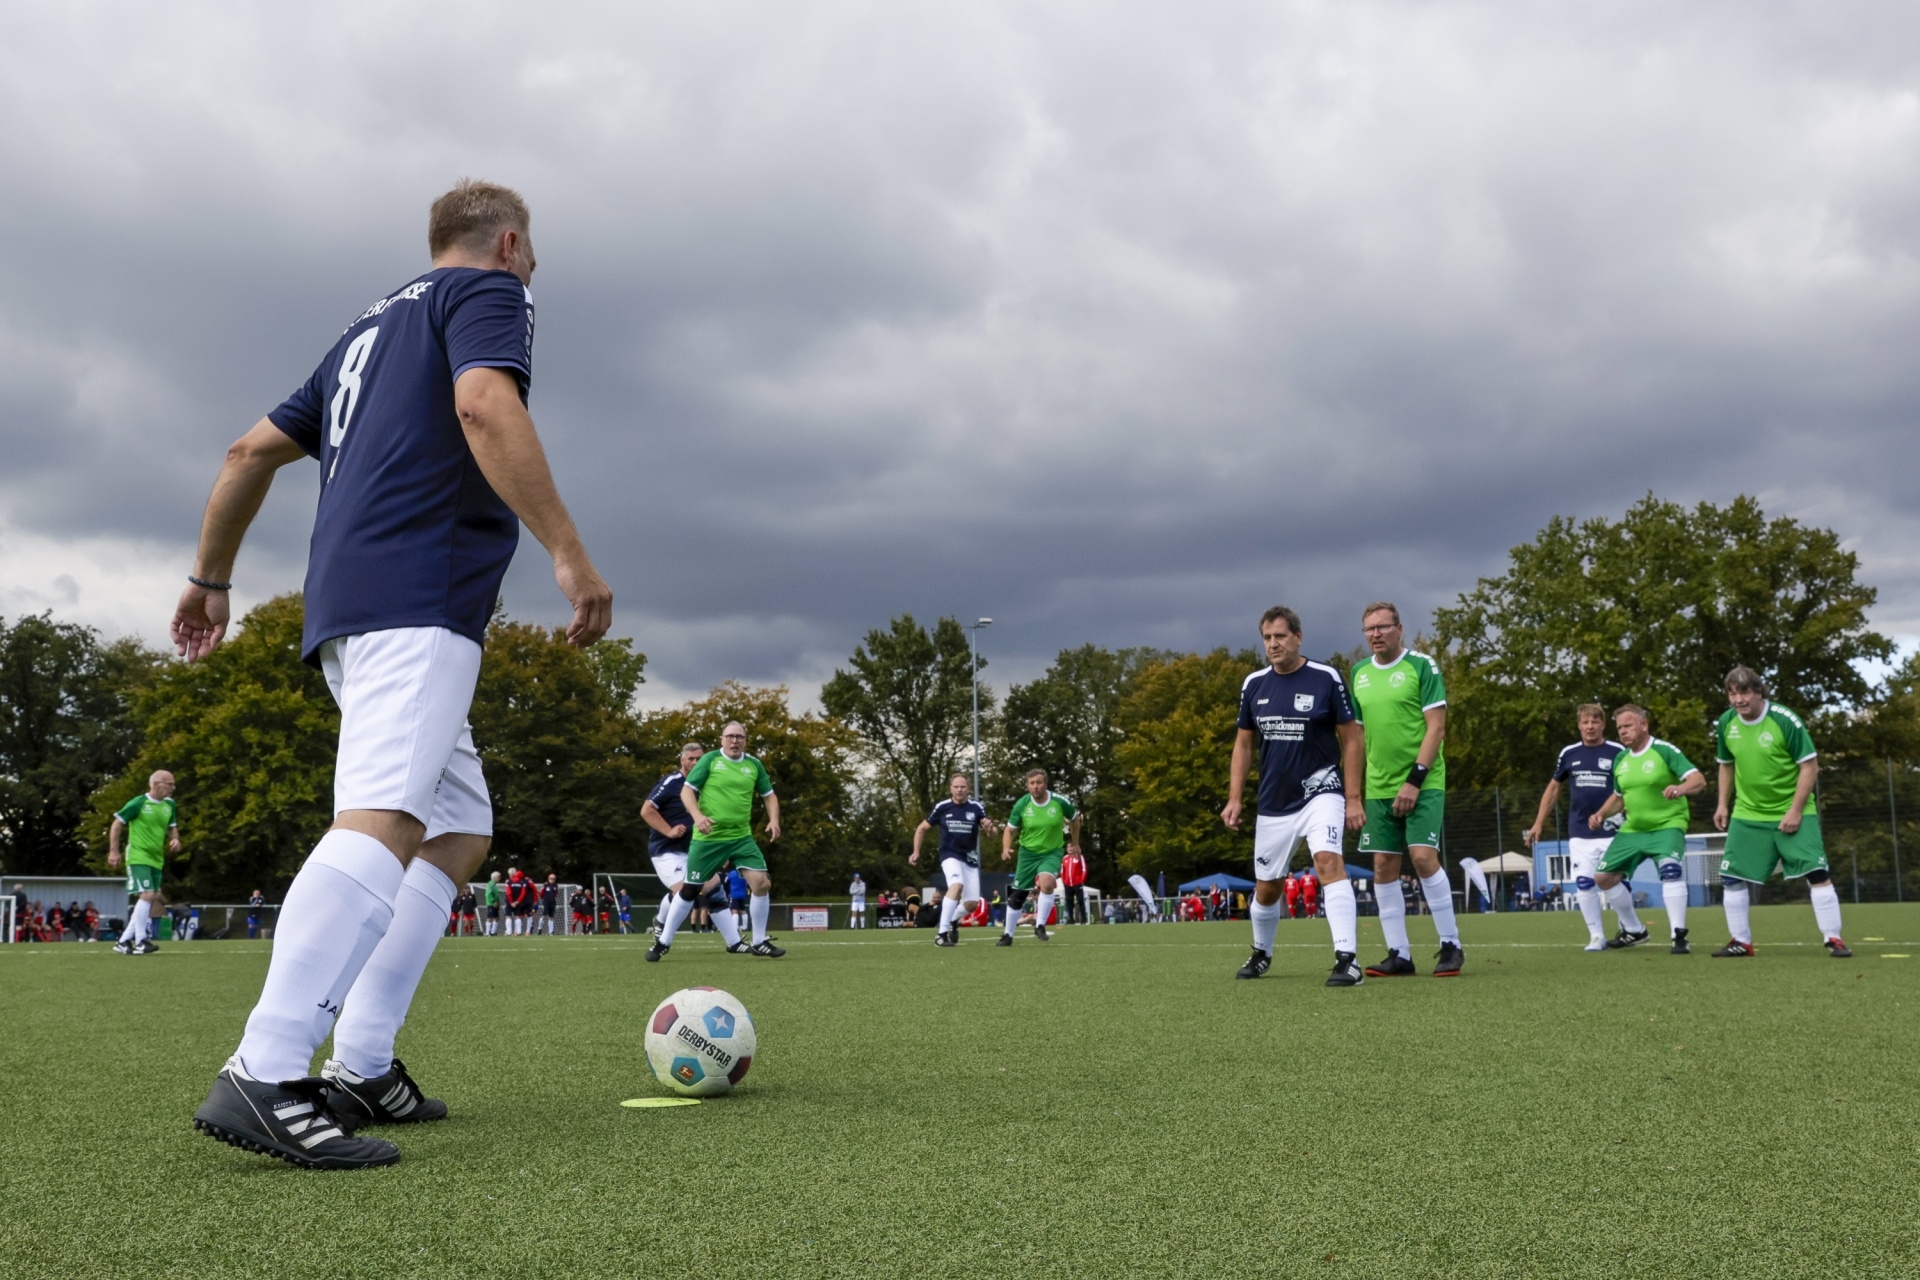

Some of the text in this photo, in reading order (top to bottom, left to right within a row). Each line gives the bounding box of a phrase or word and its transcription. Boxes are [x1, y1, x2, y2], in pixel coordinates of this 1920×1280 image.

[329, 325, 379, 448] 8
[1327, 826, 1337, 840] 15
[1362, 833, 1370, 846] 15
[690, 871, 700, 880] 24
[317, 999, 340, 1018] JA
[677, 1025, 732, 1067] DERBYSTAR
[323, 1063, 340, 1074] idas
